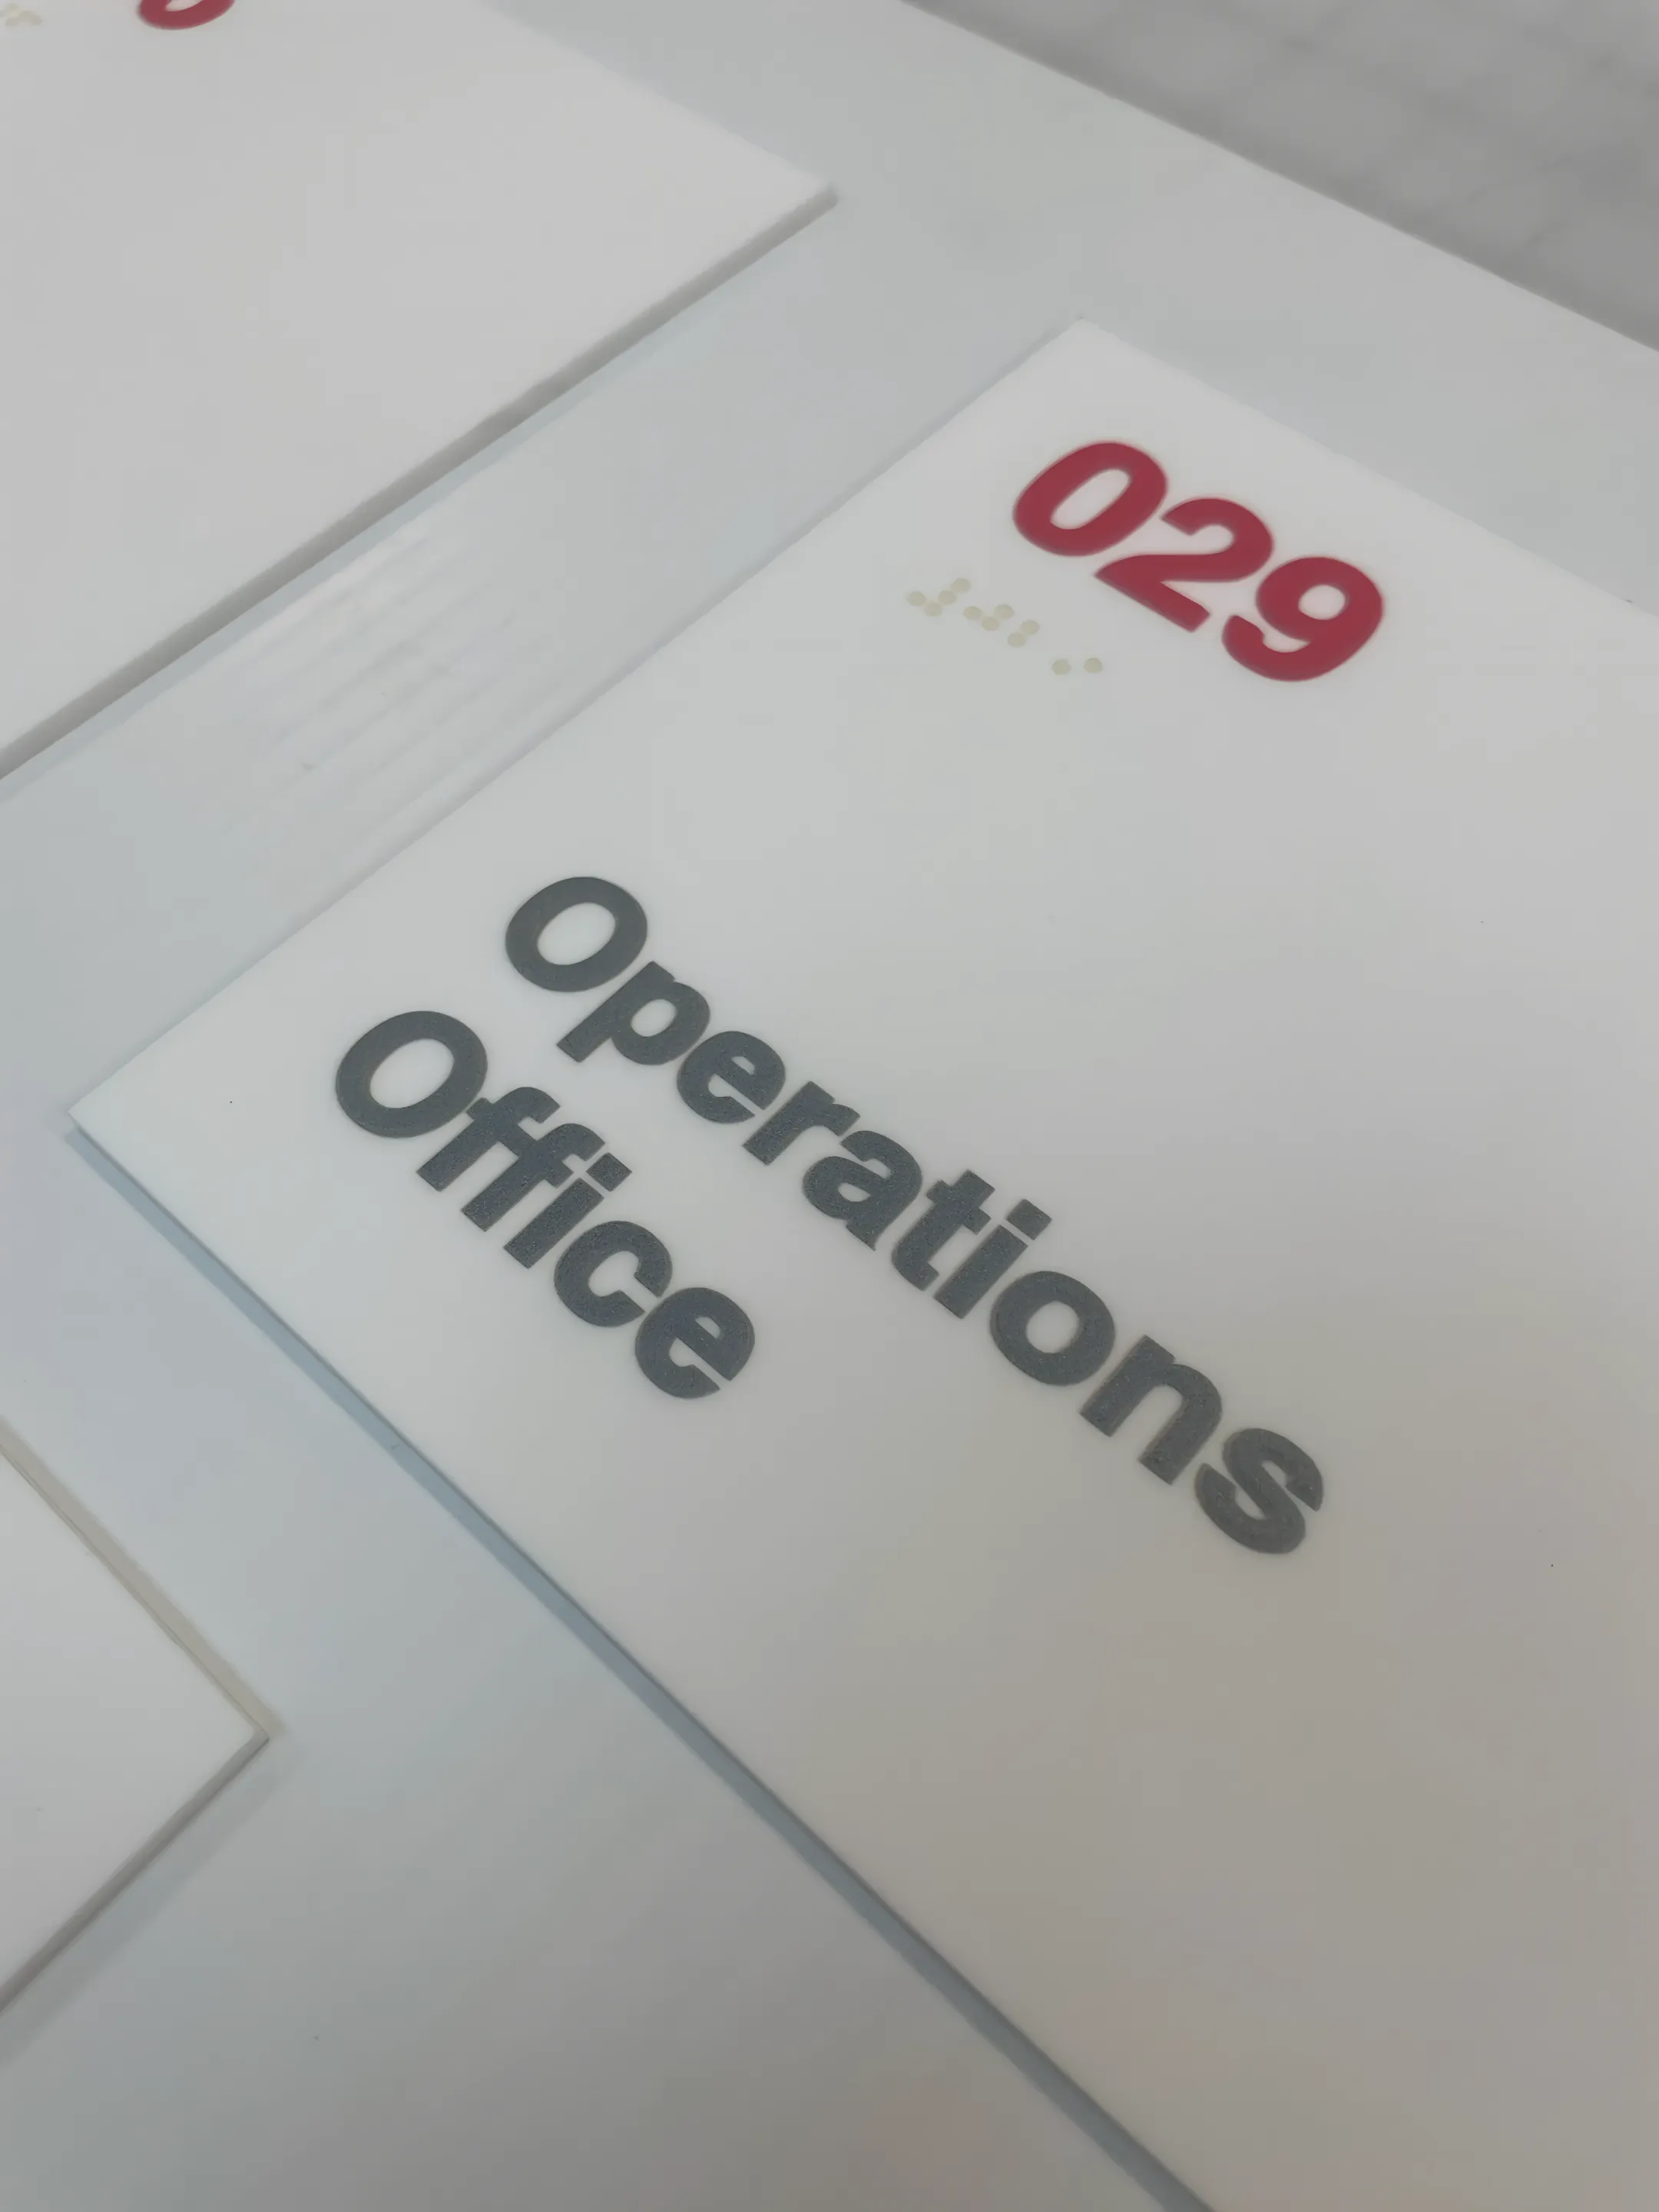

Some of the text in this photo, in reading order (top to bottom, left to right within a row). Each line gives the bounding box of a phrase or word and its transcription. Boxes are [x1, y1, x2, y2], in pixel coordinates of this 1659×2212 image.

[1012, 441, 1384, 682] 029
[334, 1009, 757, 1400] Office
[504, 876, 1326, 1557] Operations
